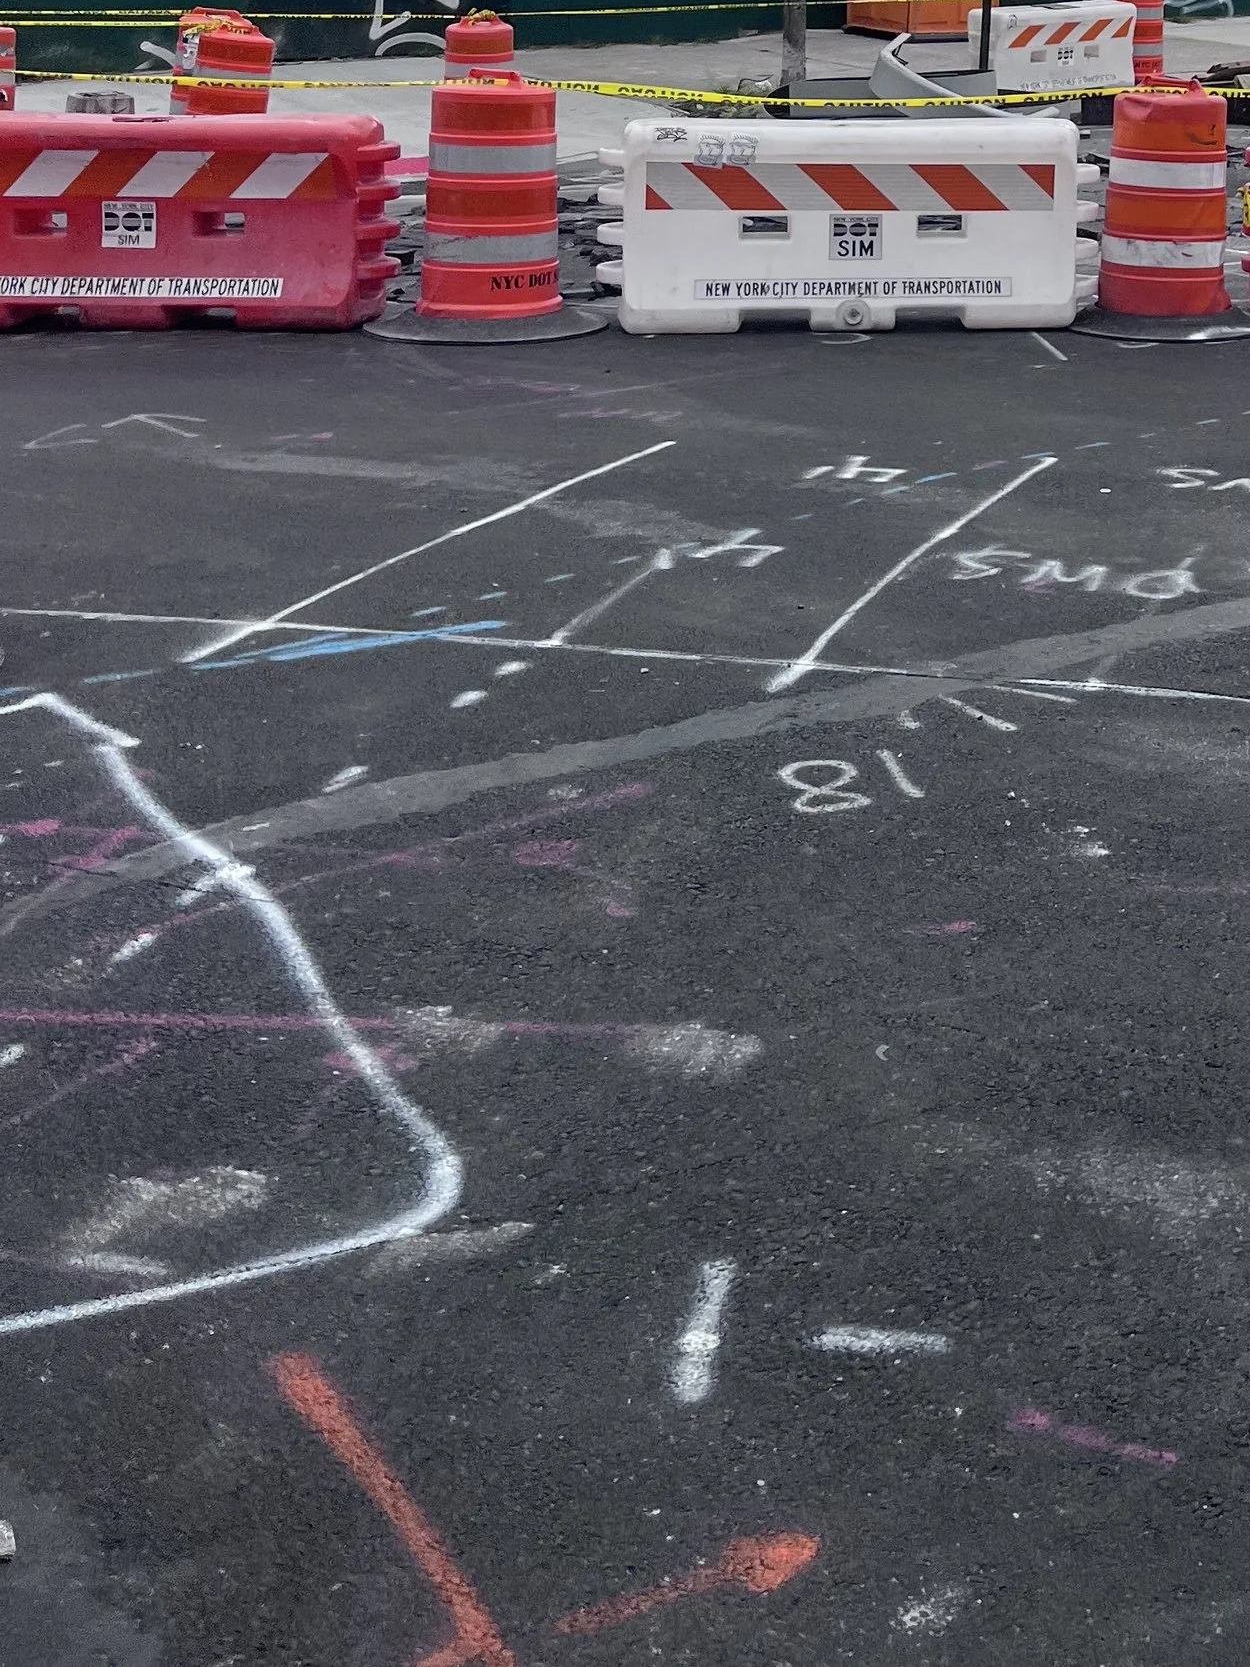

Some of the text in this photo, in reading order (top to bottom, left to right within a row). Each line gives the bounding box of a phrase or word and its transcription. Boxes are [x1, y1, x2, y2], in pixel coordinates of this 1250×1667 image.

[104, 212, 154, 232] DOT
[833, 223, 879, 237] DOT
[118, 234, 140, 245] SIM
[837, 240, 874, 257] SIM
[31, 277, 58, 296] CITY
[61, 278, 146, 296] DEPARTMENT
[148, 278, 163, 296] OF
[167, 278, 280, 296] TRANSPORTATION
[491, 272, 552, 291] NYC DOT
[705, 279, 1002, 297] NEW YORK CITY DEPARTMENT OF TRANSPORTATION
